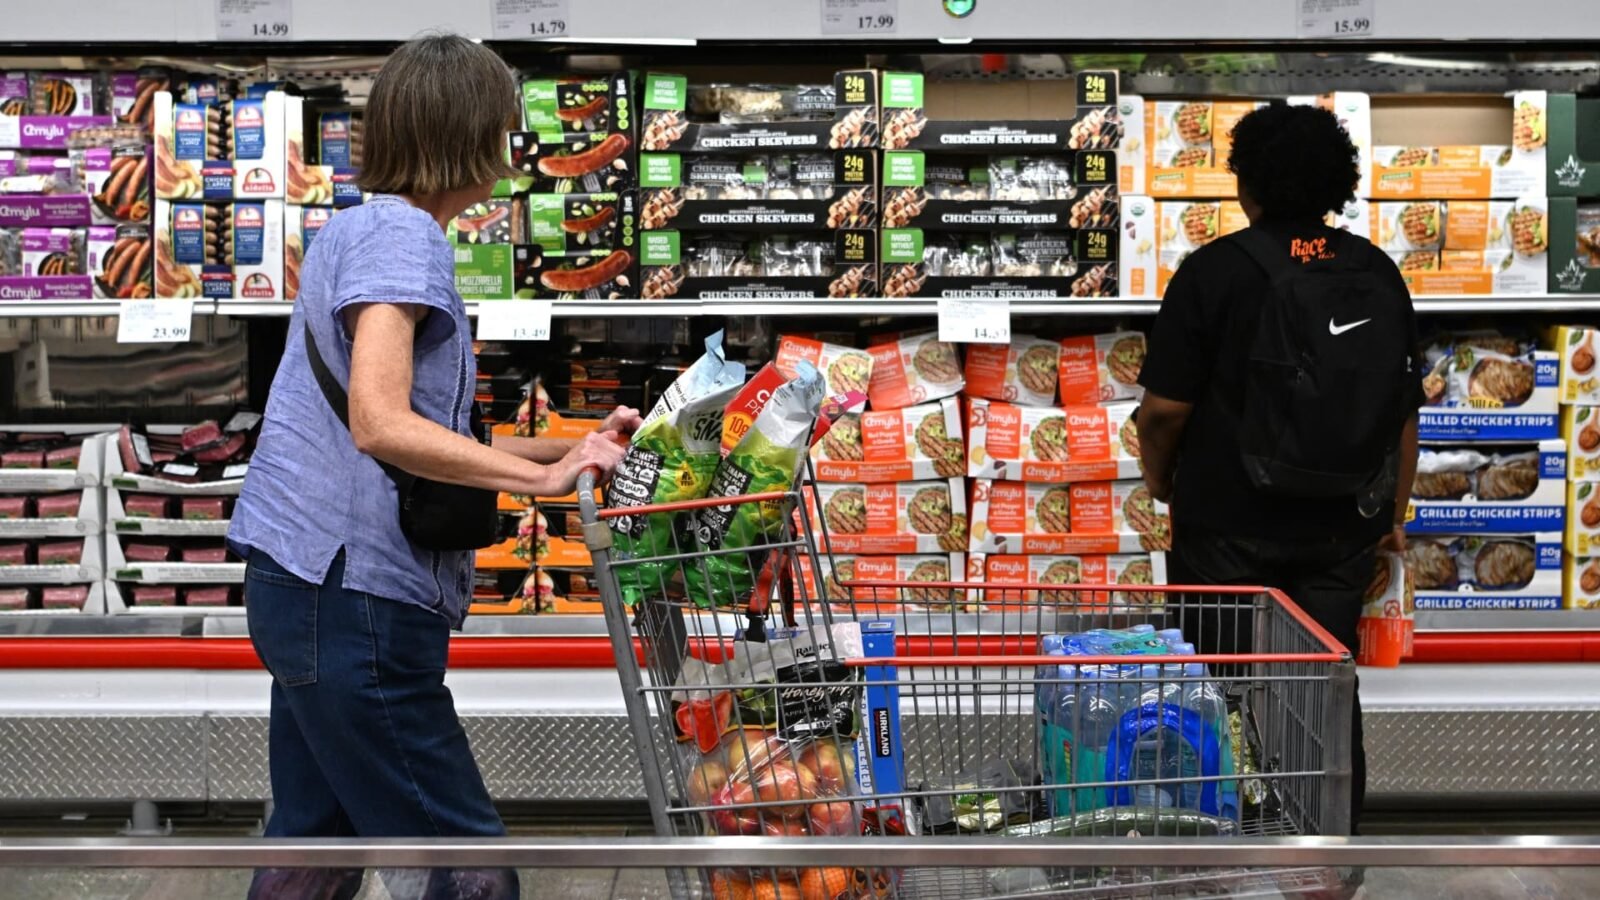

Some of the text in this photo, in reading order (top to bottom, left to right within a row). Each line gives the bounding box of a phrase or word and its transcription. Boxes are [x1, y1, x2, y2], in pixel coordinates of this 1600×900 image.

[530, 20, 566, 34] 14.79
[858, 16, 894, 28] 17.99
[1334, 20, 1370, 32] 15.99
[252, 23, 288, 36] 14.99
[701, 134, 817, 147] CHICKEN SKEWERS
[940, 134, 1057, 144] CHICKEN SKEWERS
[844, 156, 864, 171] 24g
[1086, 155, 1106, 170] 24g
[699, 214, 814, 223] CHICKEN SKEWERS
[942, 214, 1057, 223] CHICKEN SKEWERS
[846, 234, 864, 249] 24g
[1088, 232, 1107, 248] 24g
[1291, 238, 1326, 257] Race
[699, 291, 814, 299] CHICKEN SKEWERS
[941, 290, 1057, 298] CHICKEN SKEWERS
[152, 328, 187, 338] 23.99
[1537, 364, 1558, 376] 20g
[1418, 416, 1554, 426] RILLED CHICKEN STRIPS
[1545, 456, 1565, 468] 20g
[625, 483, 645, 495] SHAPE
[1420, 508, 1562, 518] GRILLED CHICKEN STRIPS
[1540, 548, 1561, 559] 20g
[1415, 599, 1557, 609] GRILLED CHICKEN STRIPS
[880, 710, 890, 756] KIRKLAND
